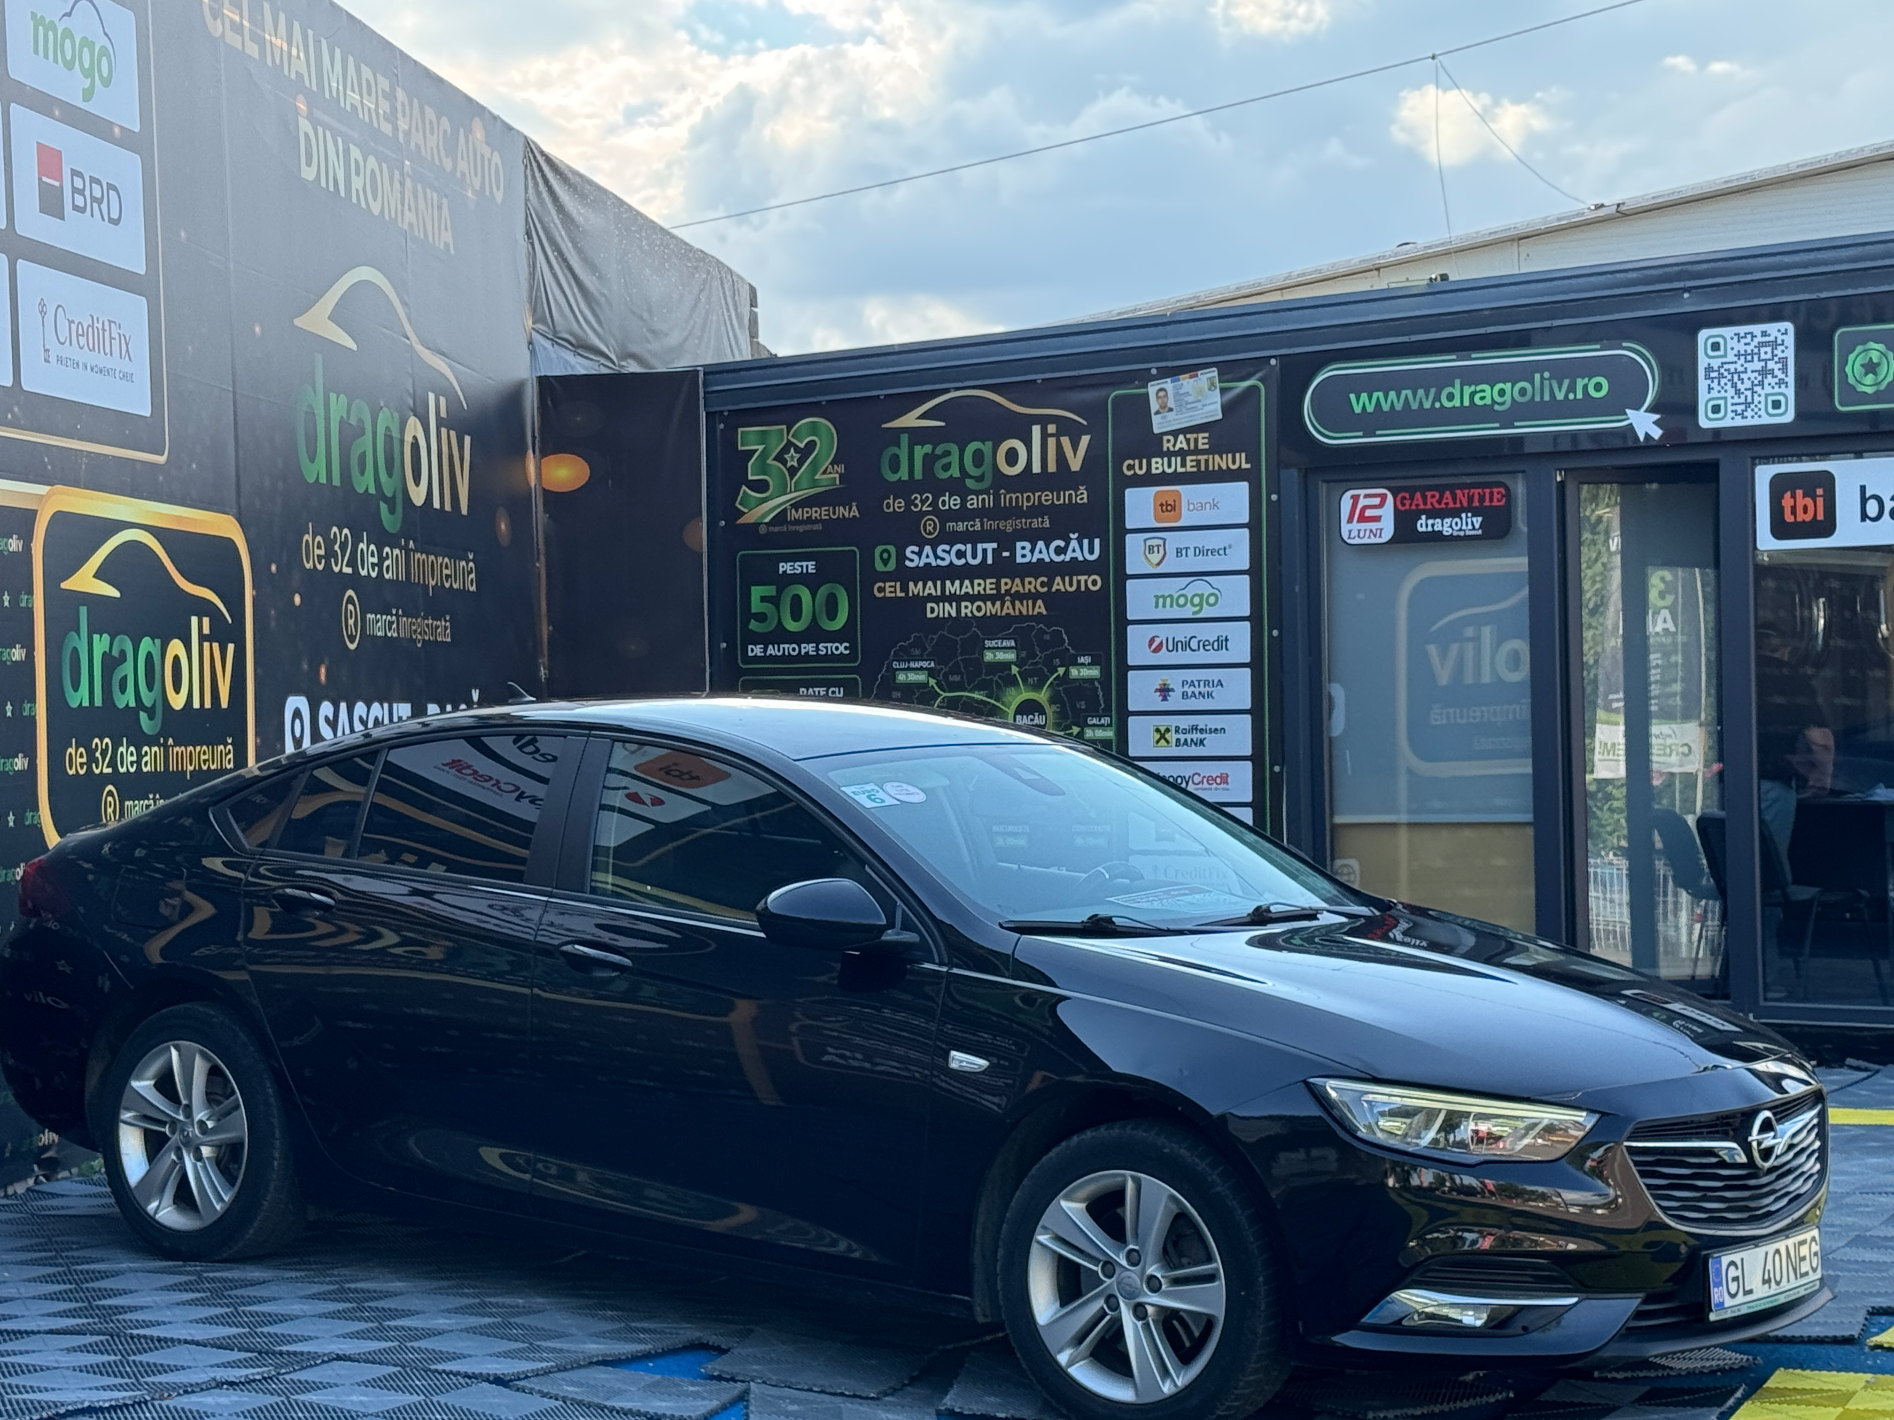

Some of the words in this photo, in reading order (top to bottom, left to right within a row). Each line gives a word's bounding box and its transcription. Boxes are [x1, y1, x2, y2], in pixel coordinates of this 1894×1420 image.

[30, 10, 113, 103] mogo
[202, 0, 259, 60] CEL
[262, 0, 318, 93] MAI
[320, 36, 393, 138] MARE
[396, 86, 453, 173] PARC
[456, 126, 504, 205] AUTO
[298, 114, 346, 198] DIN
[349, 142, 454, 255] ROMÂNIA
[70, 167, 123, 227] BRD
[54, 303, 133, 363] CreditFix
[1348, 371, 1610, 415] www.dragoliv.ro
[296, 352, 472, 534] dragoliv
[1162, 432, 1210, 451] RATE
[735, 416, 838, 513] 32
[826, 463, 845, 474] ANI
[880, 423, 1092, 491] dragoliv
[1122, 458, 1147, 476] CU
[1150, 452, 1252, 475] BULETINUL
[883, 495, 905, 513] de
[911, 493, 933, 512] 32
[938, 491, 961, 510] de
[966, 489, 994, 509] ani
[999, 485, 1088, 511] împreună
[1158, 498, 1177, 514] tbi
[1186, 498, 1220, 512] bank
[1346, 492, 1388, 525] 12
[1395, 486, 1507, 512] GARANTIE
[1781, 487, 1825, 523] tbi
[787, 502, 860, 522] ÎMPREUNĂ
[946, 518, 981, 532] marcă
[983, 515, 1050, 533] înregistrată
[1416, 512, 1483, 536] dragoliv
[1346, 527, 1385, 540] LUNI
[302, 521, 325, 571] de
[330, 525, 353, 575] 32
[357, 531, 378, 579] de
[382, 538, 406, 582] ani
[408, 539, 477, 597] împreună
[904, 542, 998, 568] SASCUT
[1015, 532, 1101, 564] BACĂU
[1147, 543, 1162, 555] BT
[1175, 546, 1190, 558] BT
[778, 561, 817, 575] PESTE
[873, 581, 906, 598] CEL
[908, 580, 941, 597] MAI
[945, 578, 997, 595] MARE
[1000, 577, 1048, 594] PARC
[1051, 574, 1102, 592] AUTO
[748, 582, 849, 633] 500
[926, 601, 957, 618] DIN
[960, 596, 1047, 617] ROMÂNIA
[1153, 591, 1219, 616] mogo
[366, 607, 398, 638] marcă
[398, 608, 452, 648] înregistrată
[747, 644, 764, 657] DE
[766, 643, 799, 656] AUTO
[801, 643, 816, 655] PE
[818, 642, 850, 655] STOC
[984, 639, 1016, 649] SUCEAVA
[1165, 634, 1230, 653] UniCredit
[61, 605, 235, 736] dragoliv
[892, 660, 935, 669] CLUJ-NAPOCA
[828, 686, 844, 698] CU
[1181, 678, 1224, 690] PATRIA
[1181, 690, 1215, 701] BANK
[1015, 712, 1046, 725] BACĂU
[1174, 724, 1226, 735] Raiffeisen
[1174, 737, 1207, 748] BANK
[65, 738, 87, 775] de
[91, 737, 113, 775] 32
[117, 737, 137, 773] de
[141, 738, 164, 772] ani
[167, 736, 234, 780] împreună
[865, 793, 886, 804] 6
[1725, 1256, 1754, 1300] GL
[1713, 1286, 1724, 1304] RO
